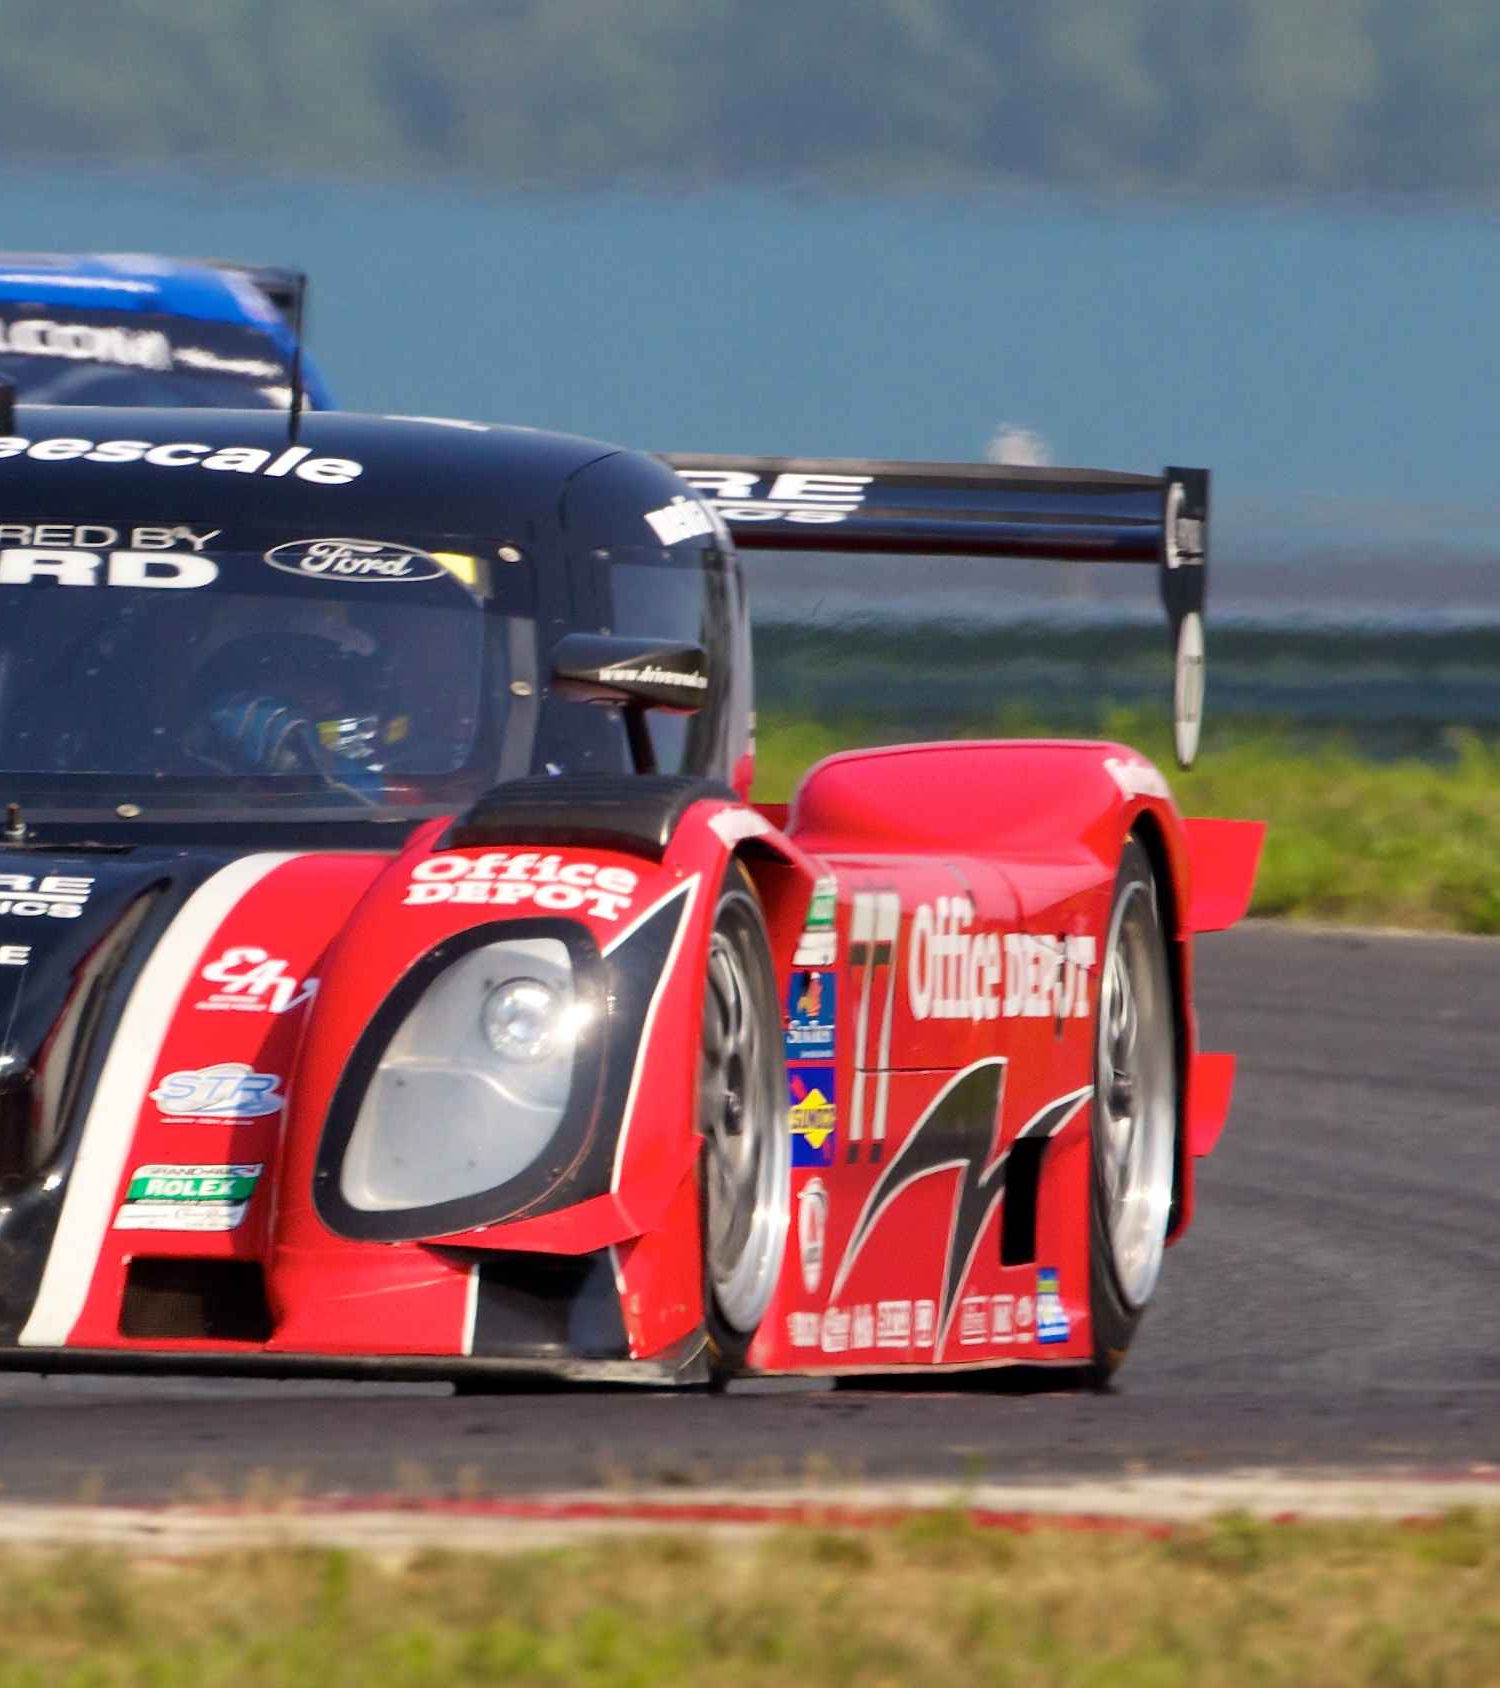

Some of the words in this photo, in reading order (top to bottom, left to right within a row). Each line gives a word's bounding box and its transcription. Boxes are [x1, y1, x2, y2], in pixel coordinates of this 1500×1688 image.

[131, 526, 222, 552] BY
[300, 541, 414, 577] Ford
[410, 852, 639, 895] Office
[402, 880, 633, 921] DEPOT
[907, 896, 1000, 1022] Office
[1002, 932, 1096, 1019] DEPOT
[144, 1178, 237, 1197] ROLEX
